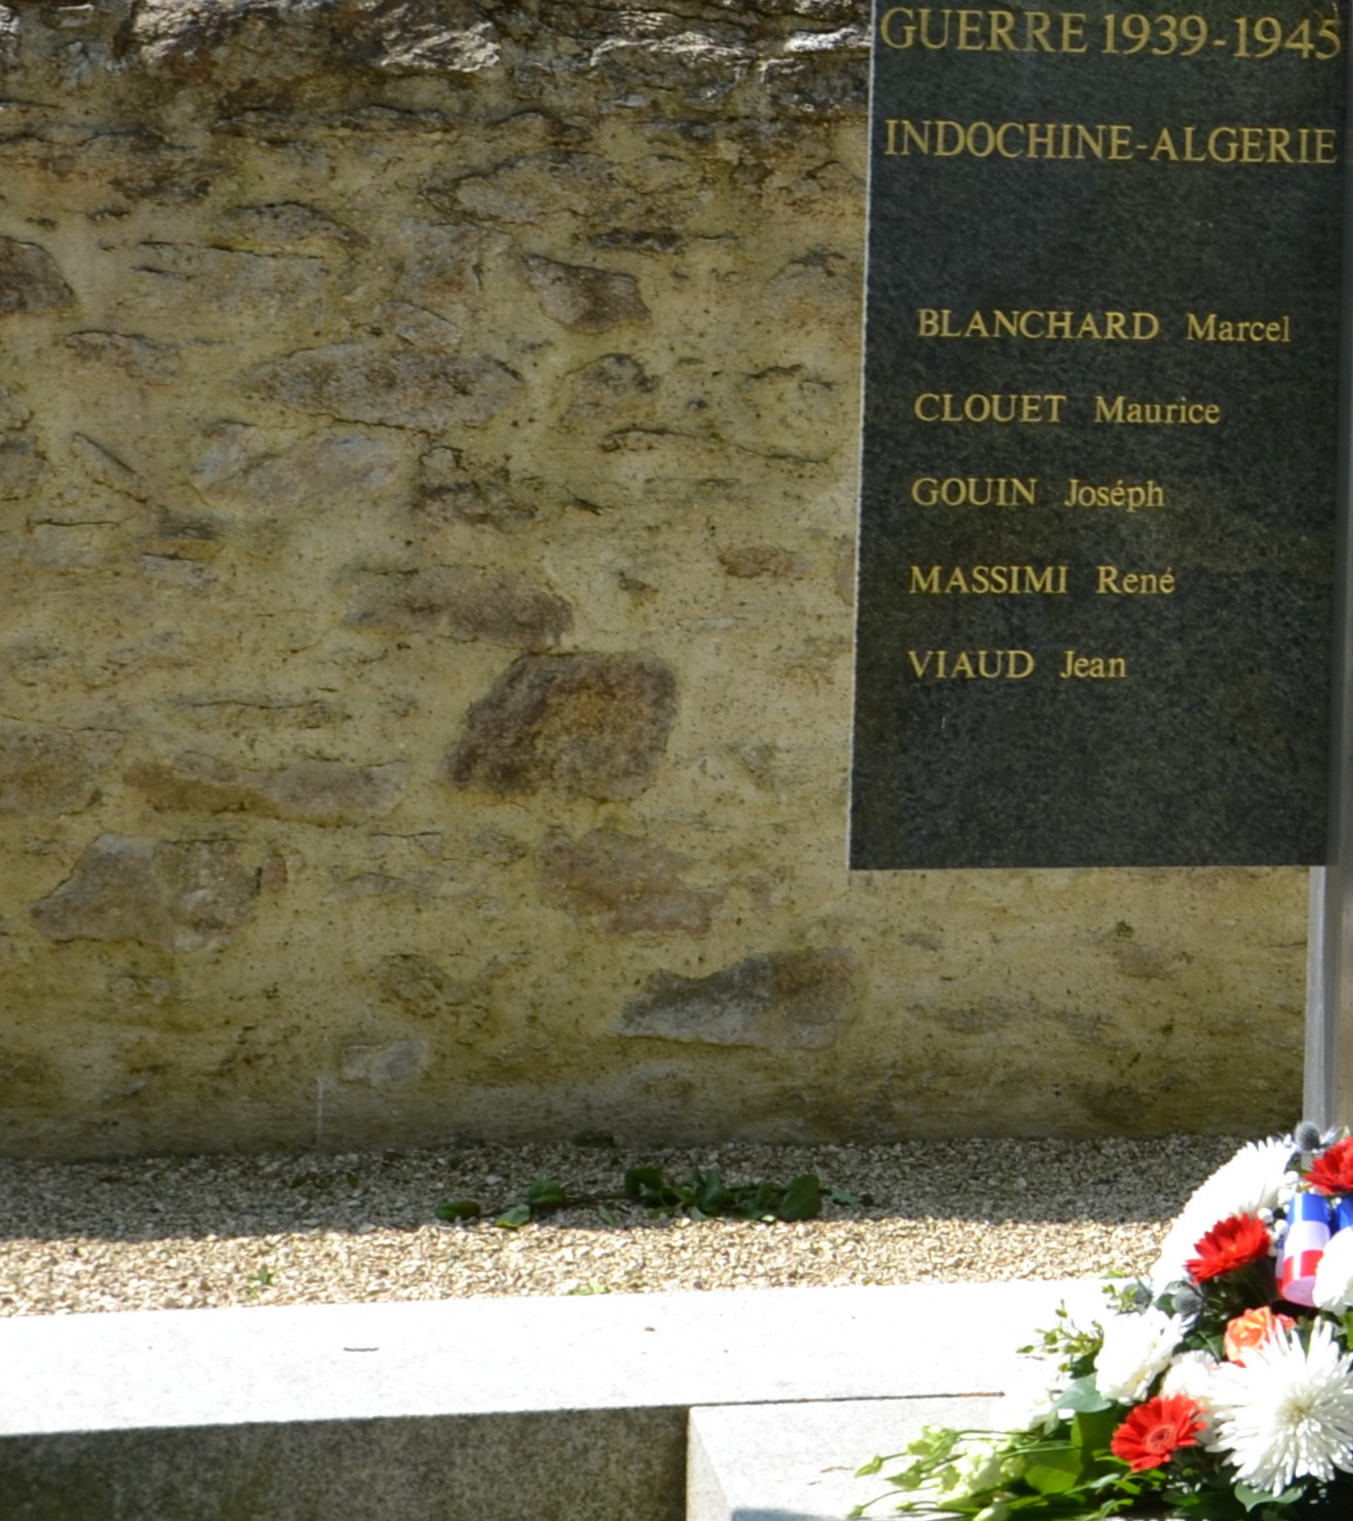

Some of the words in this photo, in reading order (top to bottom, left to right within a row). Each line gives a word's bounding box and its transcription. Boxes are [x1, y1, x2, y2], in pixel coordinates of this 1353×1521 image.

[880, 7, 1088, 54] GUERRE
[1102, 13, 1340, 60] 1939-1945
[885, 119, 1335, 164] INDOCHINE-ALGERIE
[918, 308, 1160, 341] BLANCHARD
[1186, 313, 1291, 343] Marcel
[914, 393, 1067, 423] CLOUET
[1094, 395, 1221, 425] Maurice
[911, 477, 1038, 507] GOUIN
[1064, 478, 1165, 513] Joséph
[909, 565, 1068, 594] MASSIMI
[1096, 565, 1175, 595] René
[907, 649, 1036, 679] VIAUD
[1059, 649, 1127, 679] Jean
